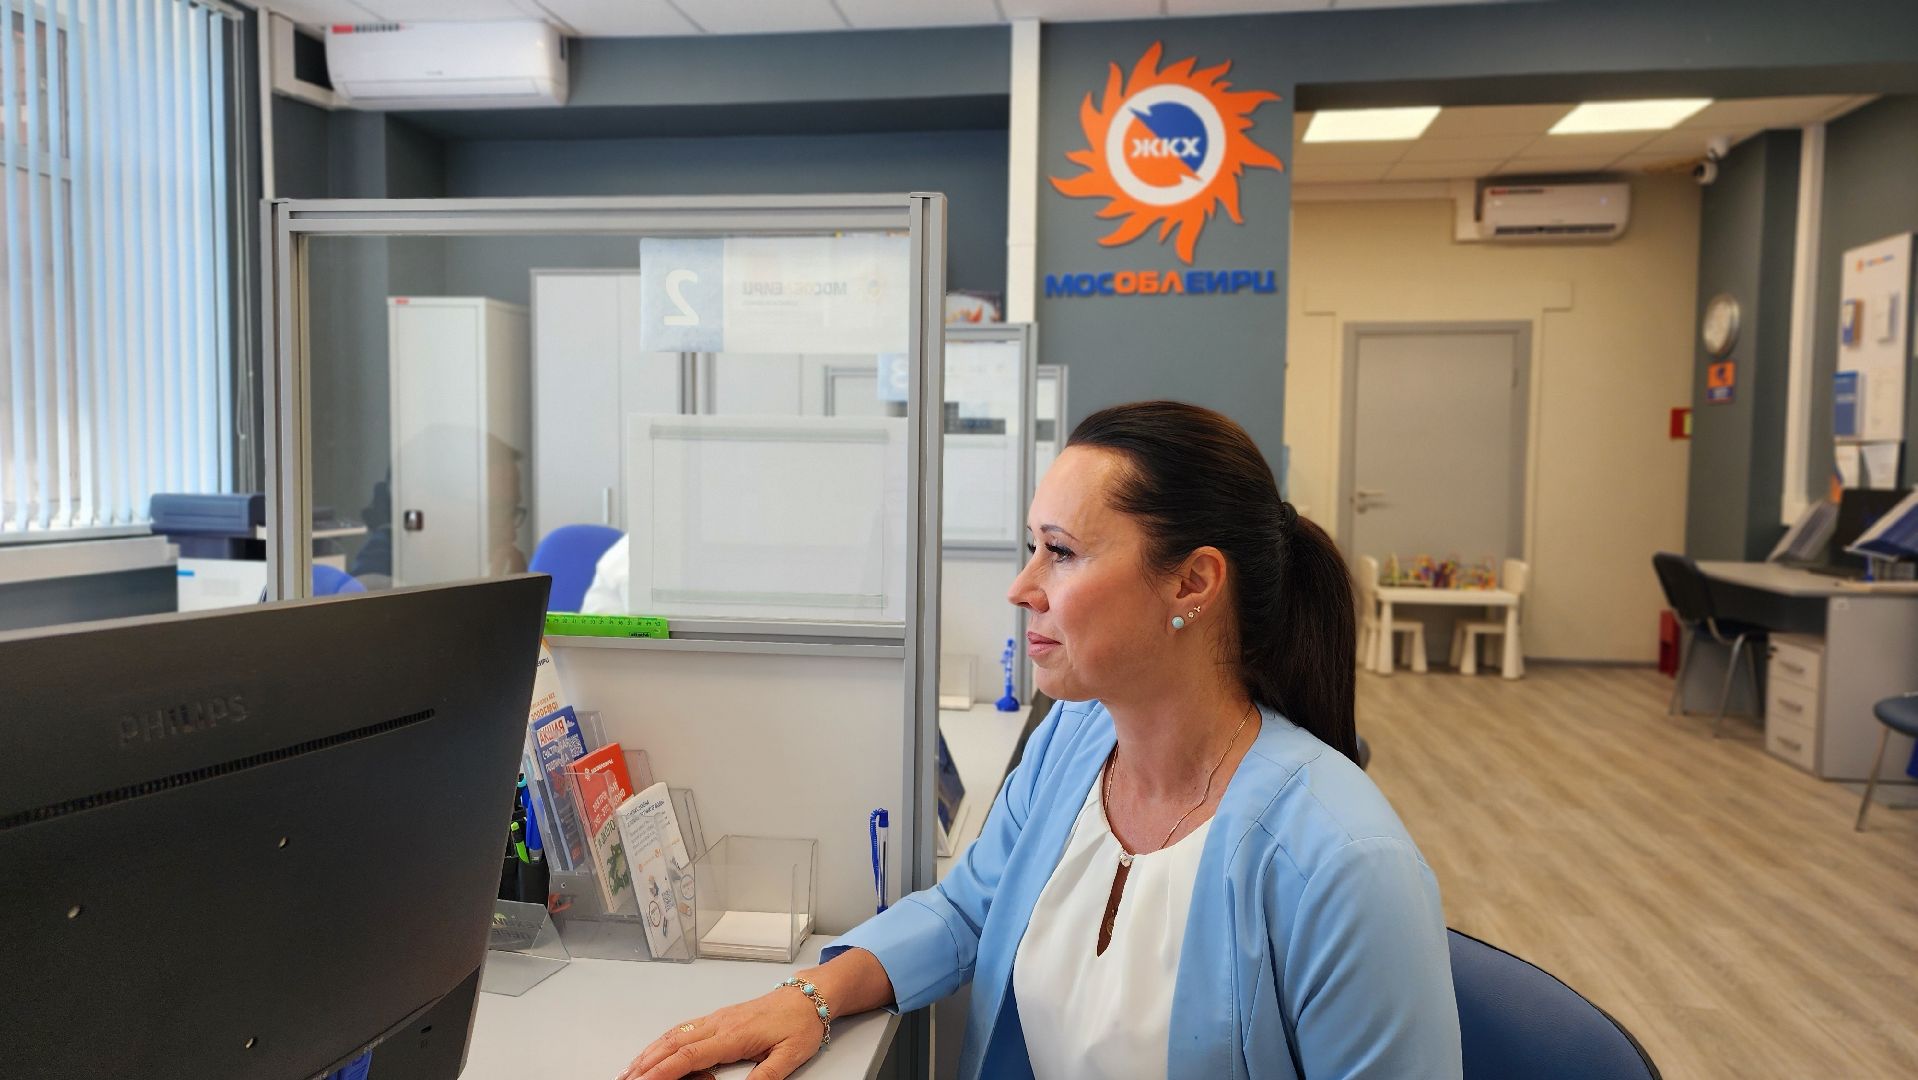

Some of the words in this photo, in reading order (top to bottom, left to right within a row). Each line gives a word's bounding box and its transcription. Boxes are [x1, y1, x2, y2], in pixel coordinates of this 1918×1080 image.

[1131, 137, 1200, 158] ЖКХ
[1045, 270, 1277, 297] МОСОБЛЕИРЦ
[119, 695, 250, 744] PHILIPS
